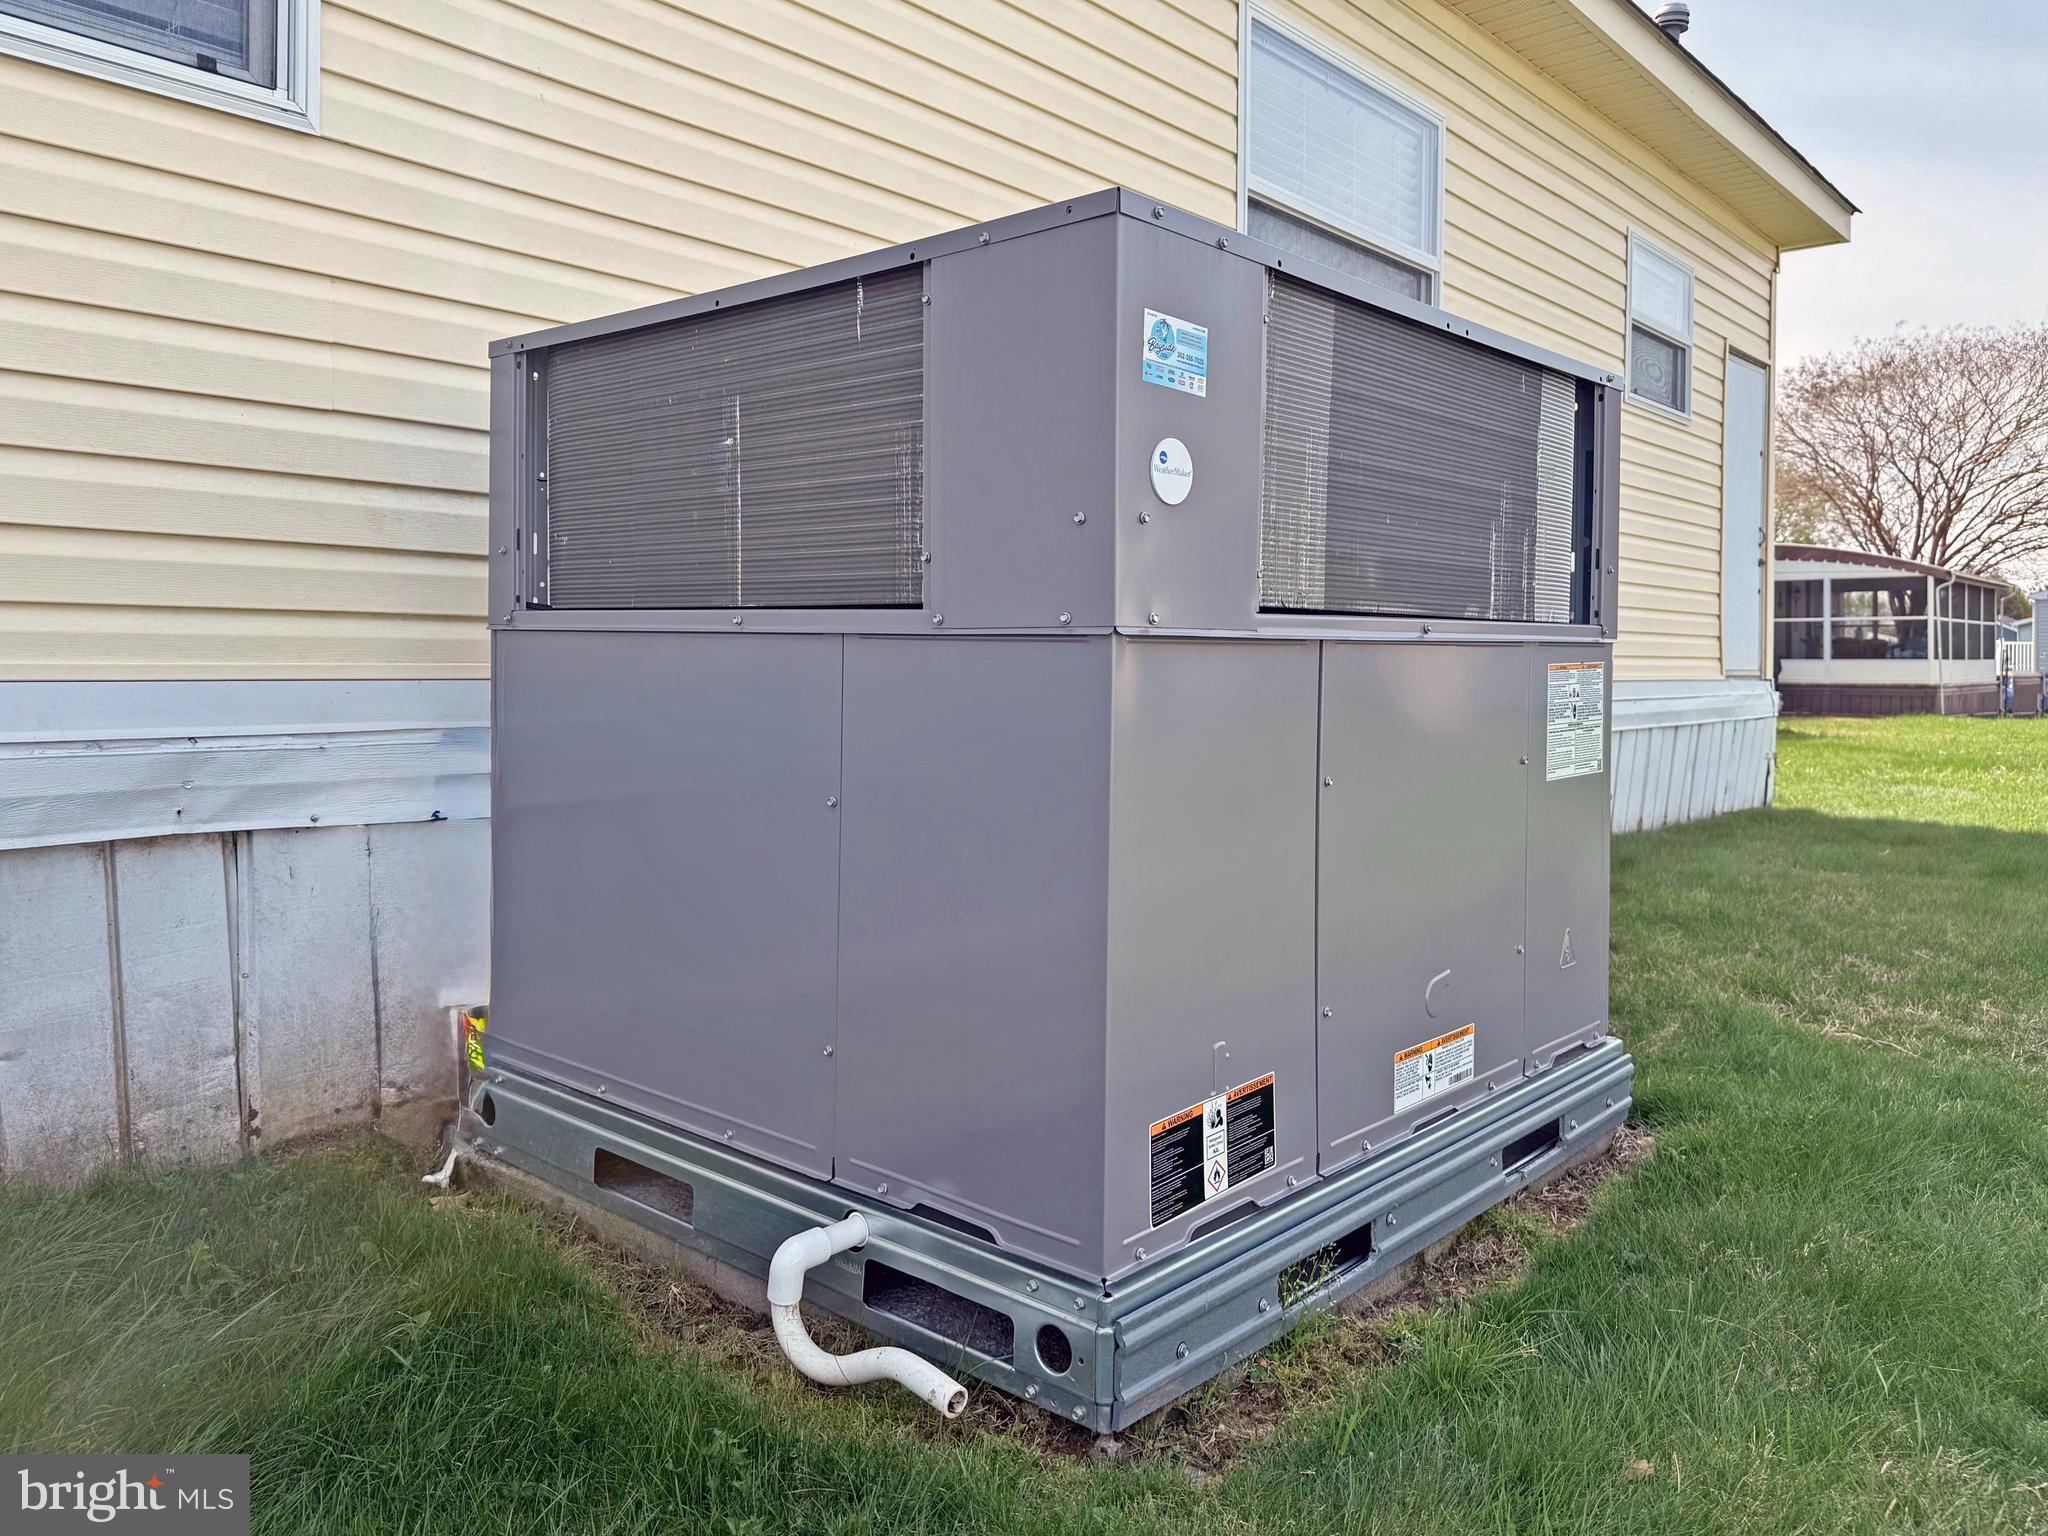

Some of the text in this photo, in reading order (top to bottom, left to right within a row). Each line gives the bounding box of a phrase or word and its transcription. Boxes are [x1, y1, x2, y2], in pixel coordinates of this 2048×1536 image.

[1147, 337, 1176, 354] Bayside
[1403, 1046, 1423, 1058] WARNING
[1233, 1075, 1273, 1099] AVERTISSEMENT
[1167, 1110, 1194, 1127] WARNING
